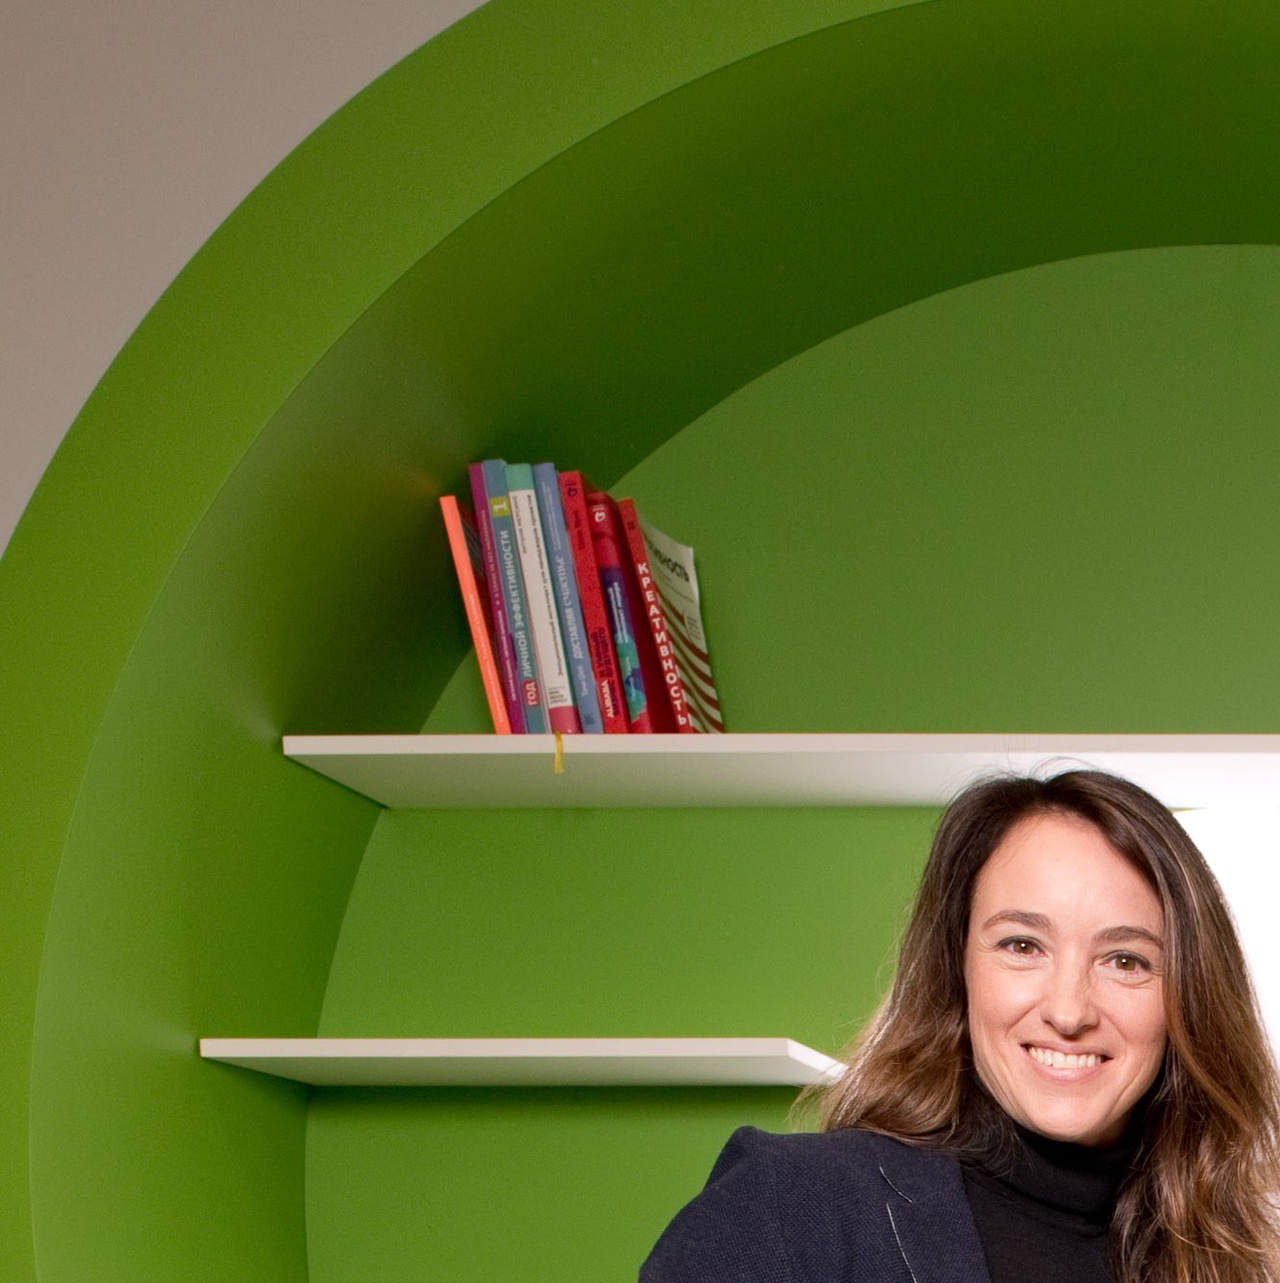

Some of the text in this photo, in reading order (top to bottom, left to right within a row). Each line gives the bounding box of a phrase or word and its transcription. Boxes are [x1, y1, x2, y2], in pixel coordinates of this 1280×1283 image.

[493, 502, 508, 511] 1
[499, 529, 525, 627] ЭФФЕКТИВНОСТИ
[516, 630, 532, 678] ЛИЧНОЙ
[562, 607, 584, 660] ДОСТАВЛЯЯ
[637, 562, 687, 725] КРЕАТИВНОСТЬ
[524, 681, 537, 705] ГОД
[600, 680, 614, 718] ALIBABA
